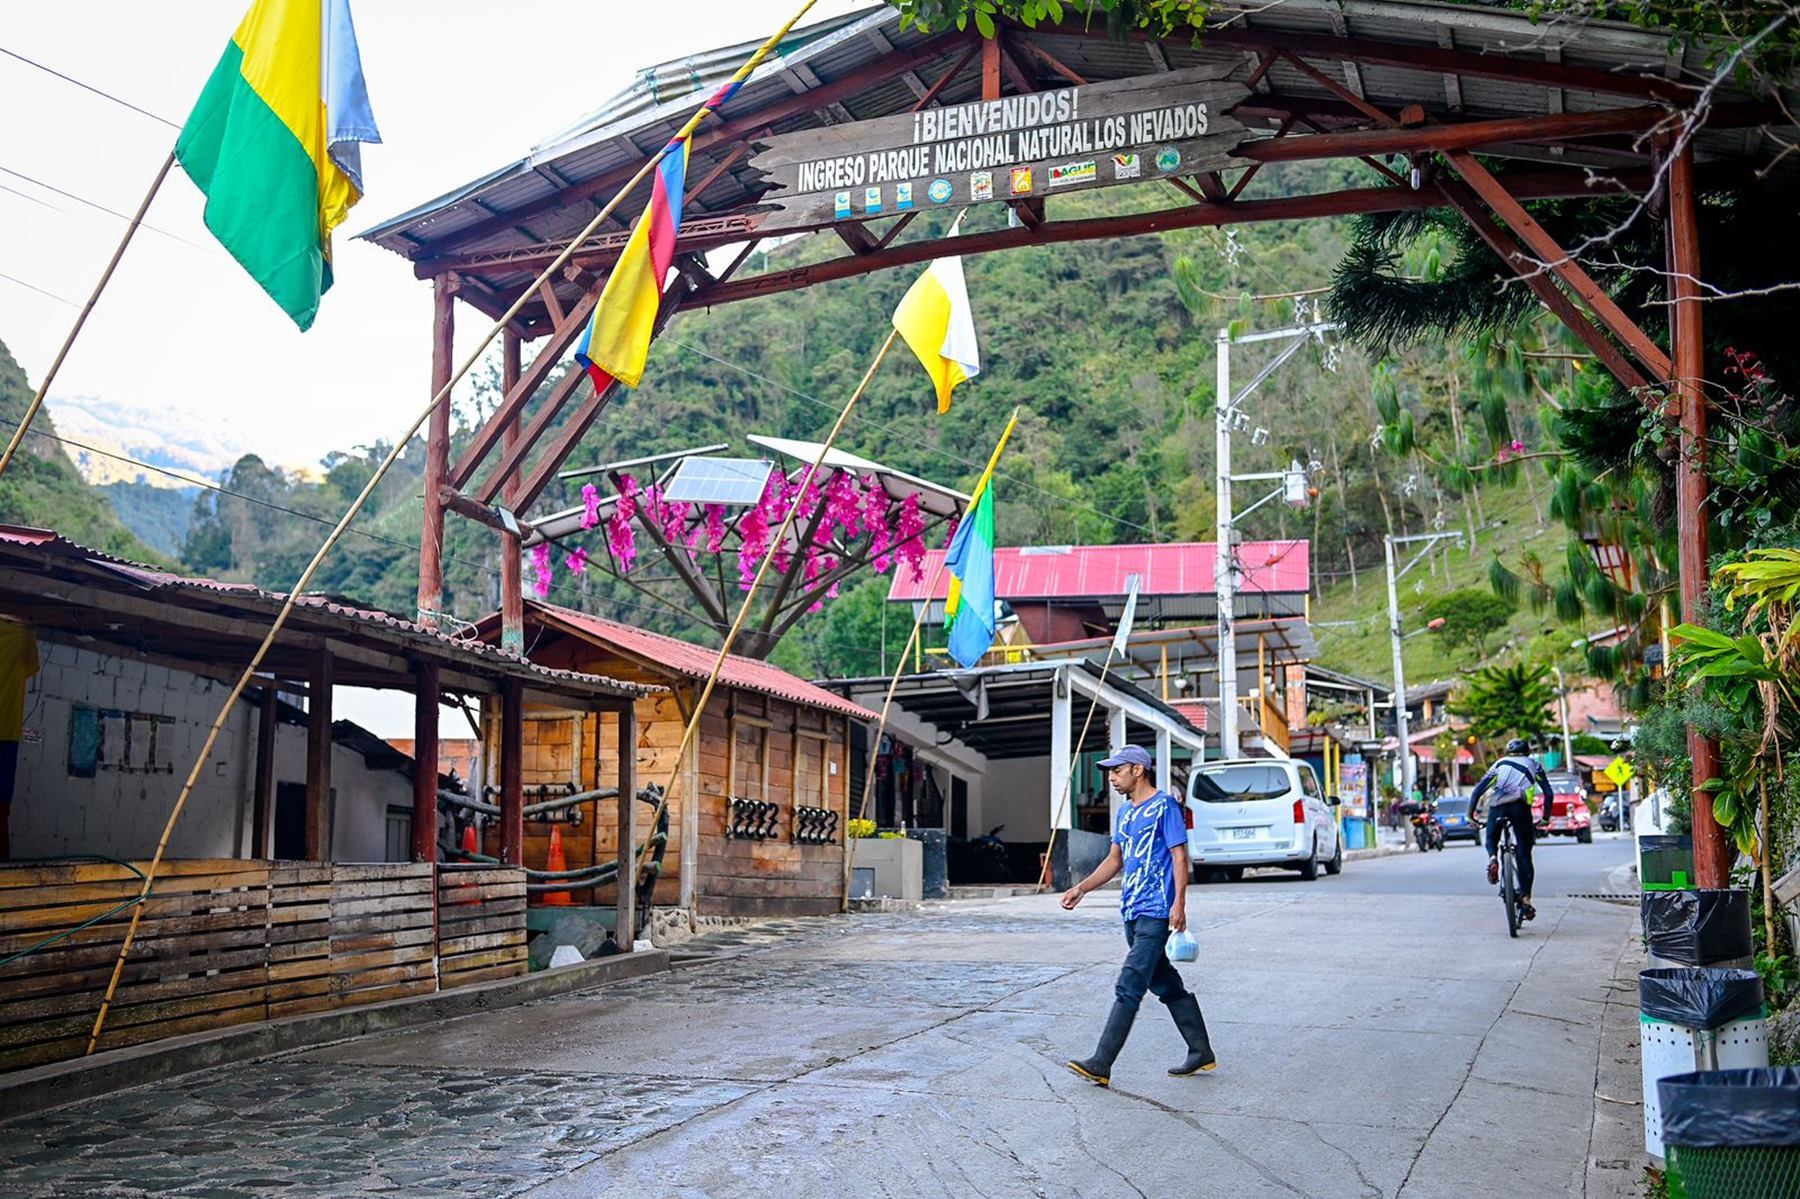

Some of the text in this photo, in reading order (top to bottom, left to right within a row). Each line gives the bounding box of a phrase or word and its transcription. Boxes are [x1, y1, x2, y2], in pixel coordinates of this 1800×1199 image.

[798, 103, 1208, 192] INGRESO PARQUE NACIONAL NATURAL LOS NEVADOS
[914, 88, 1078, 143] ¡BIENVENIDOS!
